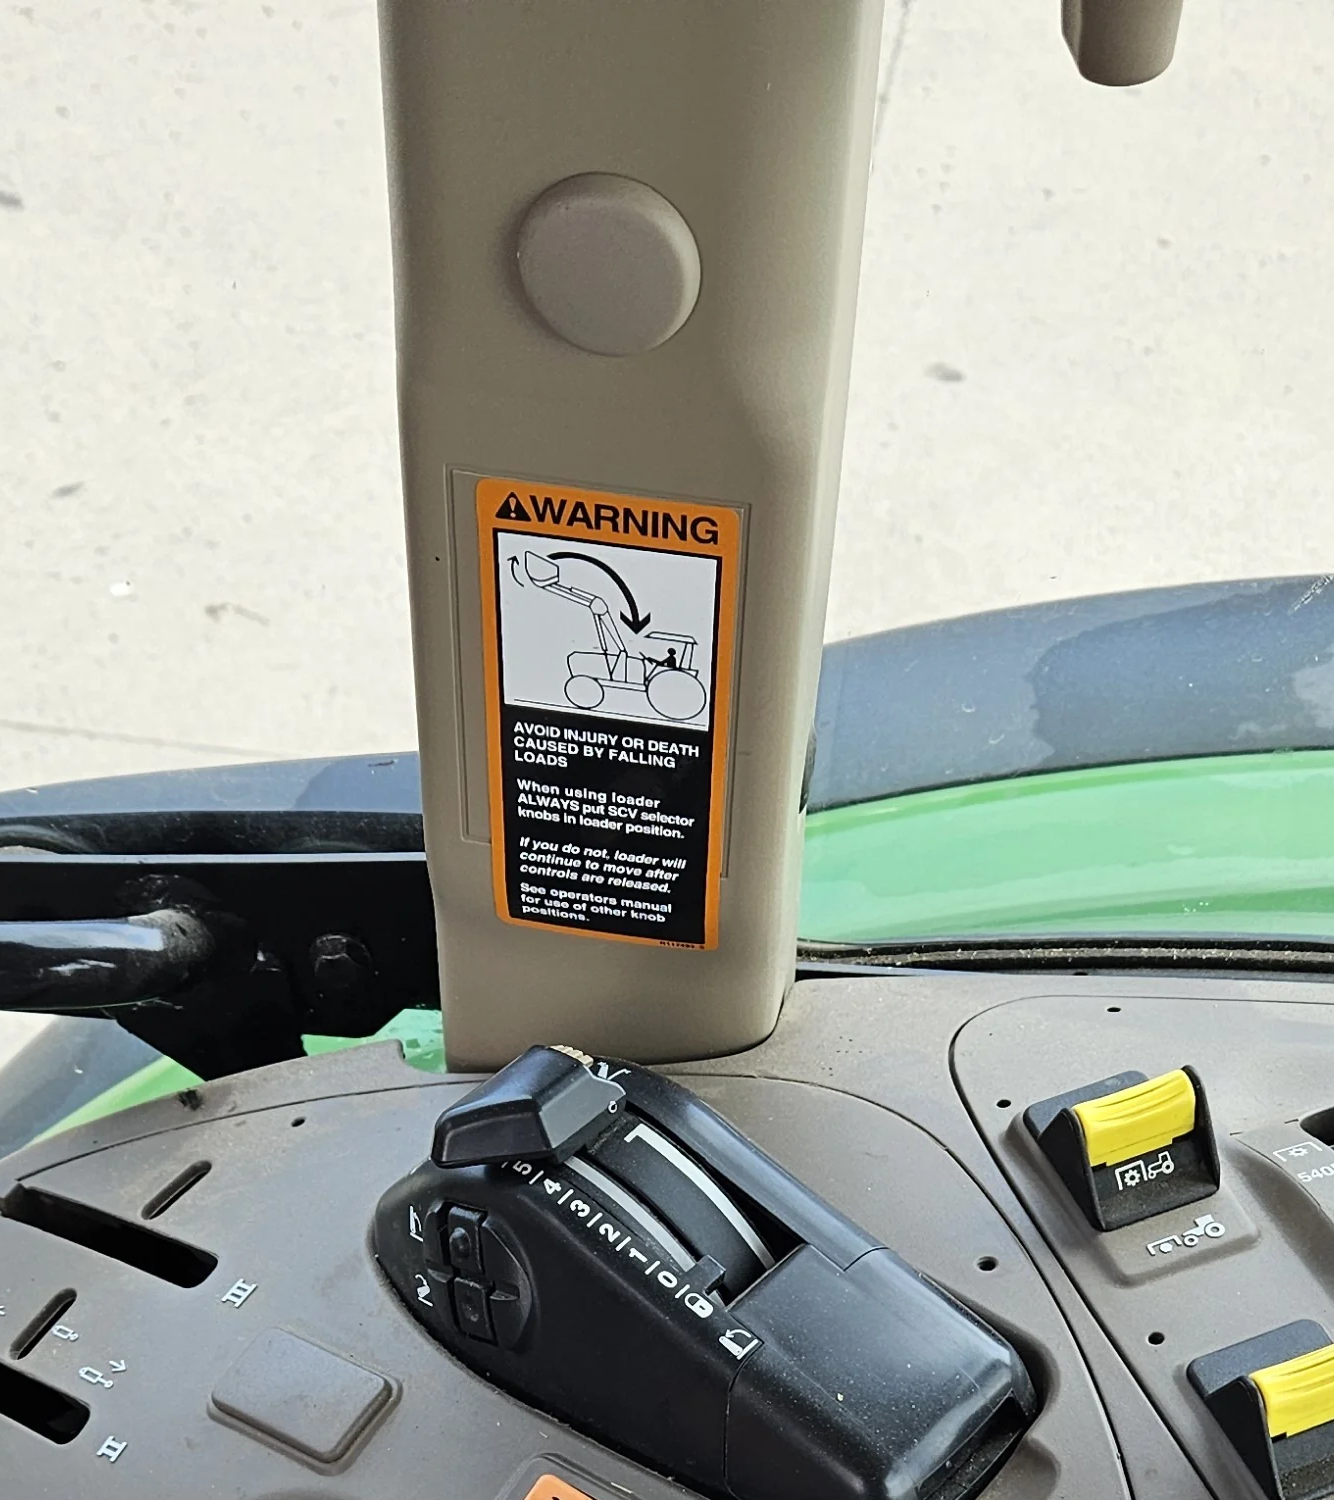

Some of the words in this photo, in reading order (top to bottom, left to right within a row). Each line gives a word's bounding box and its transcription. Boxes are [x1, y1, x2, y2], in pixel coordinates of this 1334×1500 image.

[530, 495, 718, 545] WARNING
[514, 722, 560, 737] AVOID
[564, 729, 618, 746] INJURY
[622, 737, 644, 750] OR
[648, 740, 699, 757] DEATH
[514, 736, 579, 754] CAUSED
[584, 746, 604, 758] BY
[609, 749, 675, 768] FALLING
[514, 750, 567, 768] LOADS
[517, 778, 559, 795] When
[565, 788, 607, 803] using
[612, 792, 661, 808] loader
[518, 793, 579, 811] ALWAYS
[583, 804, 605, 815] put
[608, 806, 638, 819] SCV
[641, 811, 695, 827] selector
[518, 806, 560, 822] knobs
[564, 813, 576, 824] in
[580, 815, 623, 830] loader
[626, 823, 684, 839] position.
[519, 837, 530, 847] If
[532, 839, 558, 851] you
[562, 843, 580, 854] do
[614, 850, 659, 865] loader
[662, 858, 687, 869] will
[519, 851, 581, 867] continue
[585, 859, 599, 870] to
[603, 864, 642, 876] move
[645, 869, 679, 882] after
[519, 865, 578, 880] controls
[581, 874, 604, 884] are
[608, 877, 671, 893] released.
[520, 882, 546, 894] See
[550, 889, 617, 905] operators
[621, 899, 672, 913] manual
[521, 894, 540, 904] for
[544, 899, 569, 908] use
[573, 902, 586, 911] of
[590, 905, 627, 917] other
[631, 910, 665, 922] knob
[522, 904, 590, 921] positions.
[513, 1160, 532, 1175] 5
[543, 1178, 561, 1195] 4
[570, 1199, 590, 1217] 3
[599, 1223, 621, 1242] 2
[629, 1247, 647, 1262] 1
[657, 1271, 678, 1288] 0
